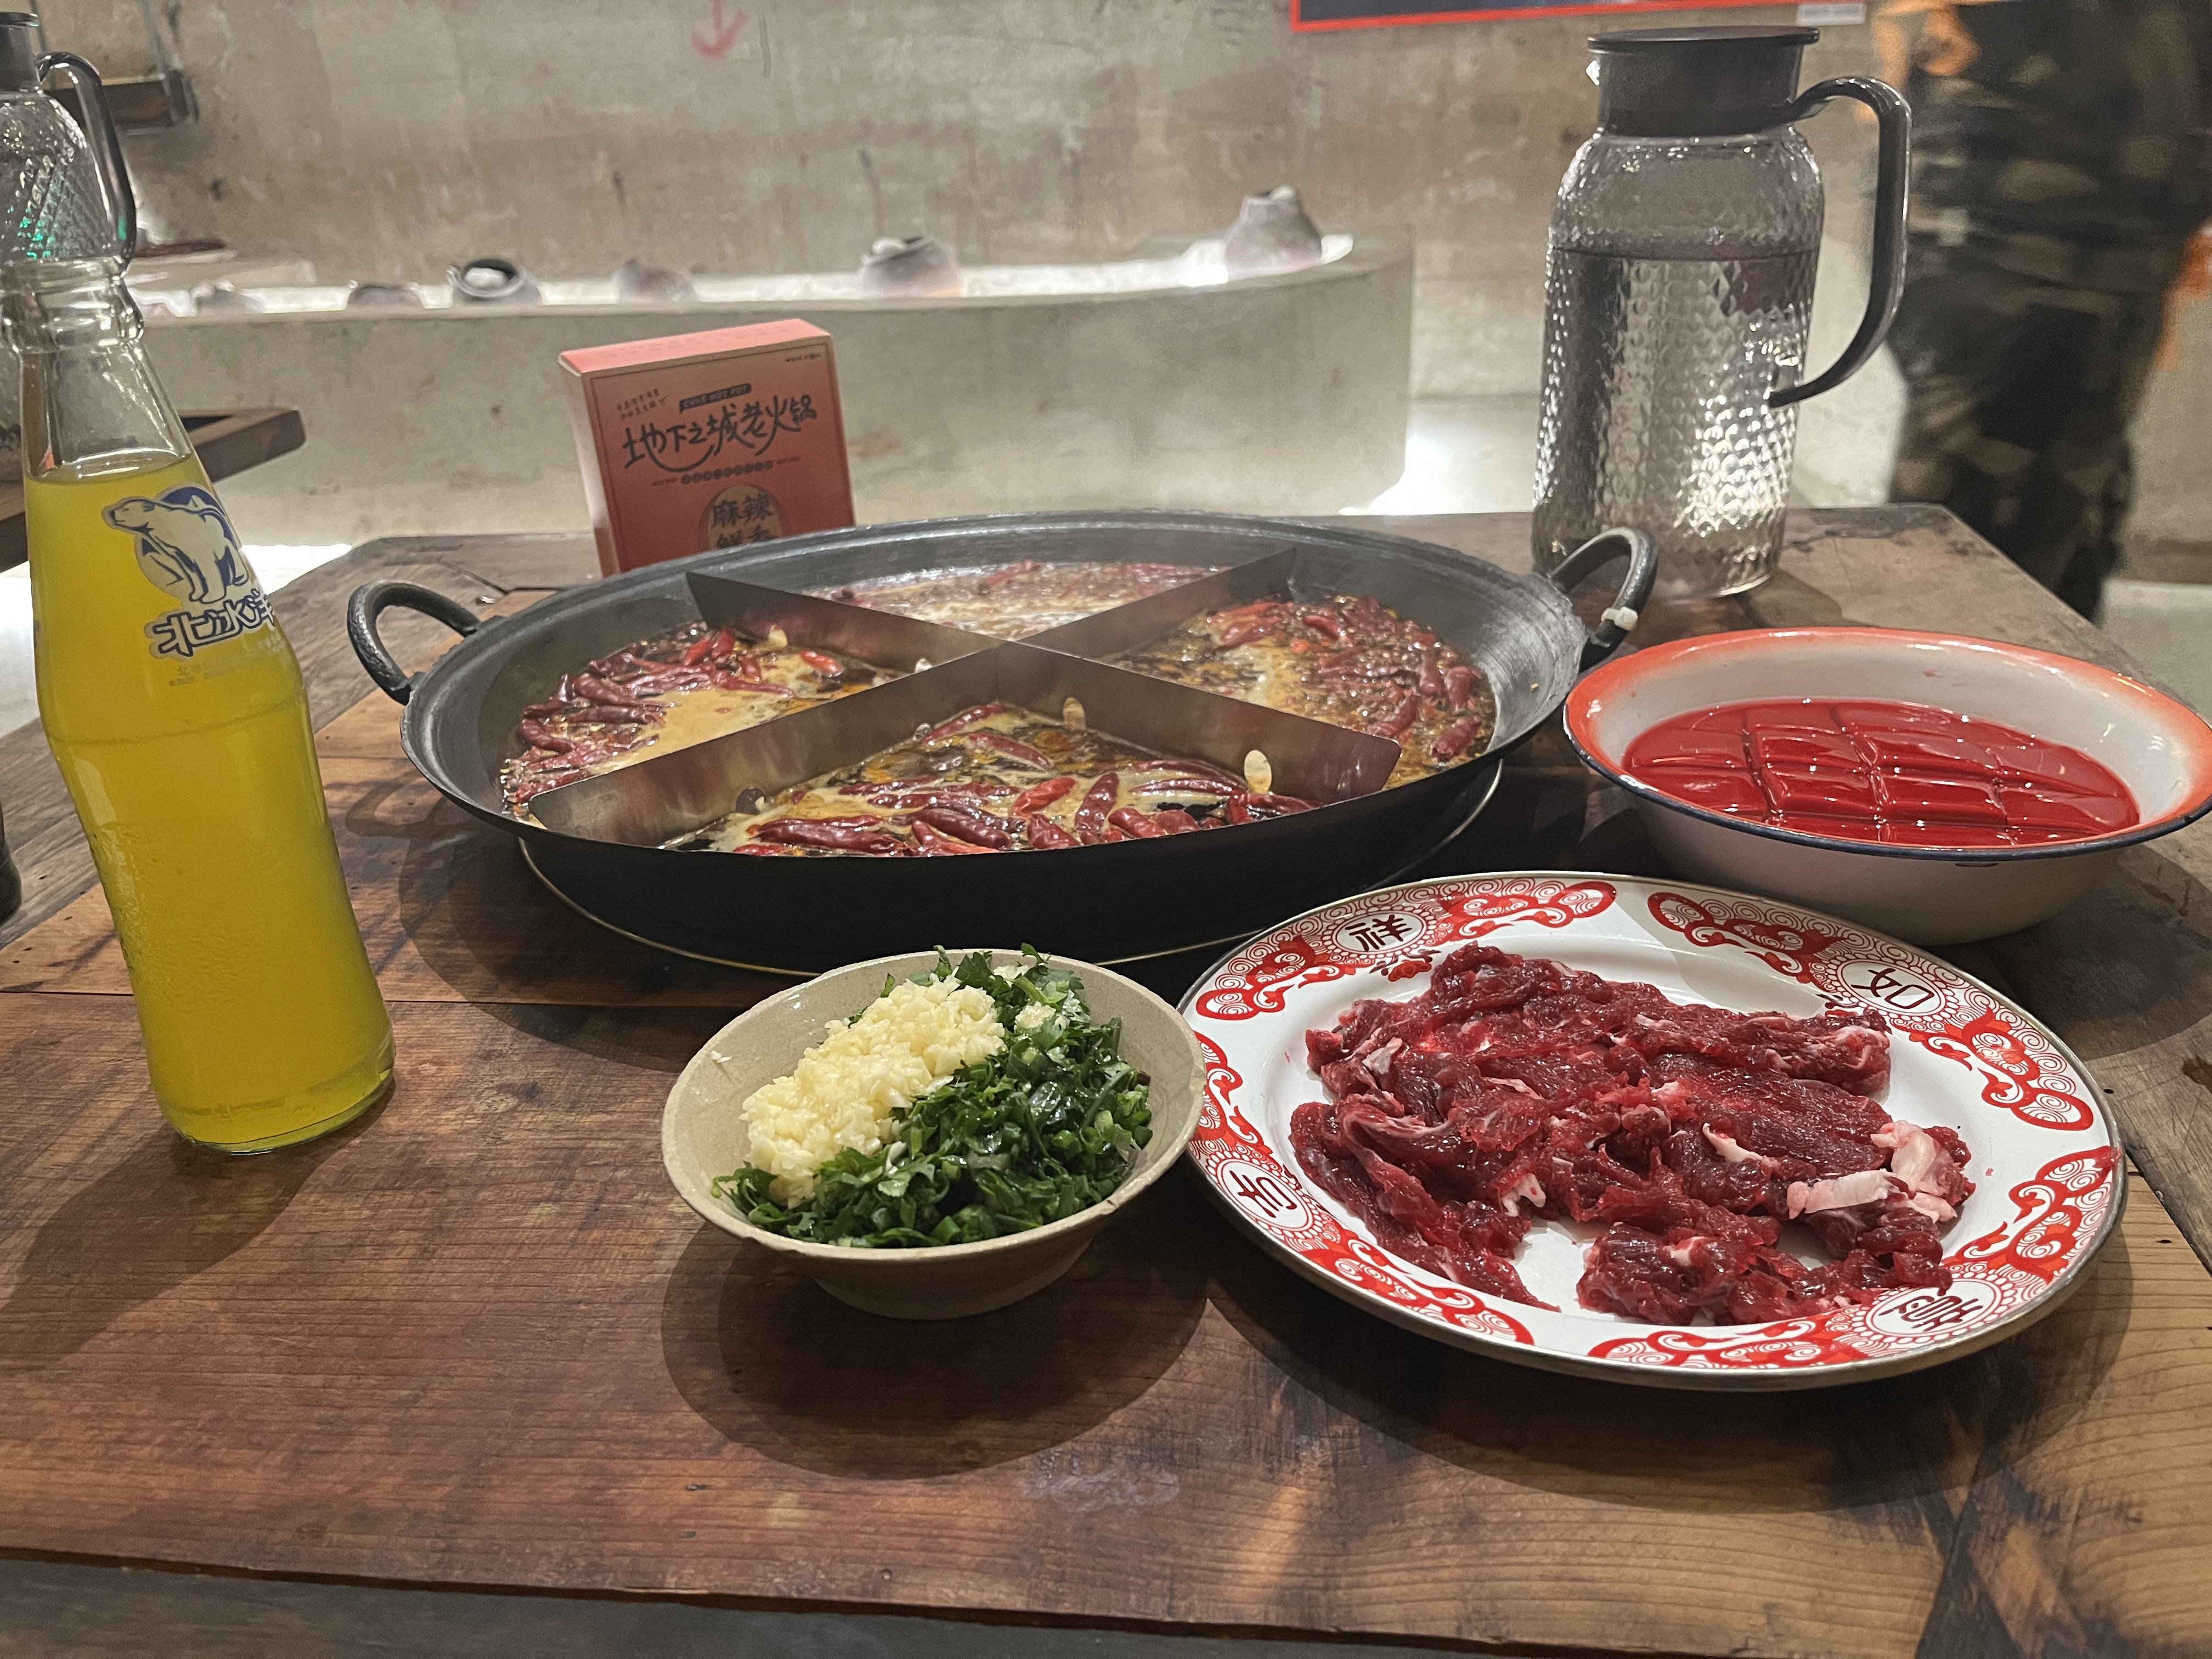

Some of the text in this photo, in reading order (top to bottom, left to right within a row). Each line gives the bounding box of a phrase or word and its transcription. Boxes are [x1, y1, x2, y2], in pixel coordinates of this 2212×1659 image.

[623, 394, 817, 472] 地下之城老火锅
[710, 493, 774, 529] 麻辣
[153, 588, 274, 657] 北冰洋
[1345, 914, 1413, 951] 祥
[1850, 968, 1935, 1008] 如
[1229, 1170, 1296, 1218] 吉
